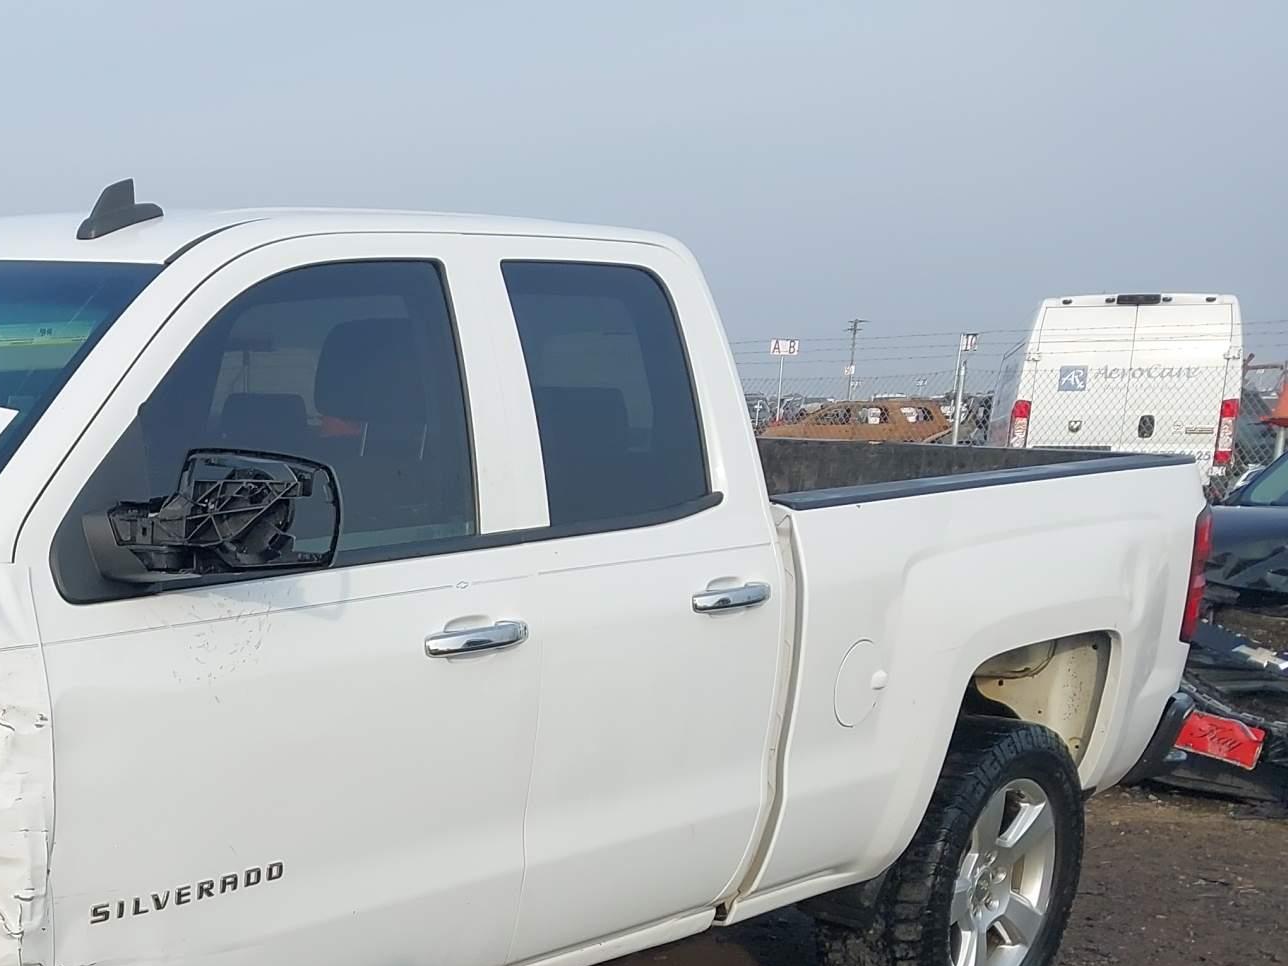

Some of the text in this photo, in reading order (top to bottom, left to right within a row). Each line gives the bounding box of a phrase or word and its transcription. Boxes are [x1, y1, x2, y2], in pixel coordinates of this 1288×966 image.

[772, 338, 797, 354] A B
[90, 862, 284, 925] SILVERADO
